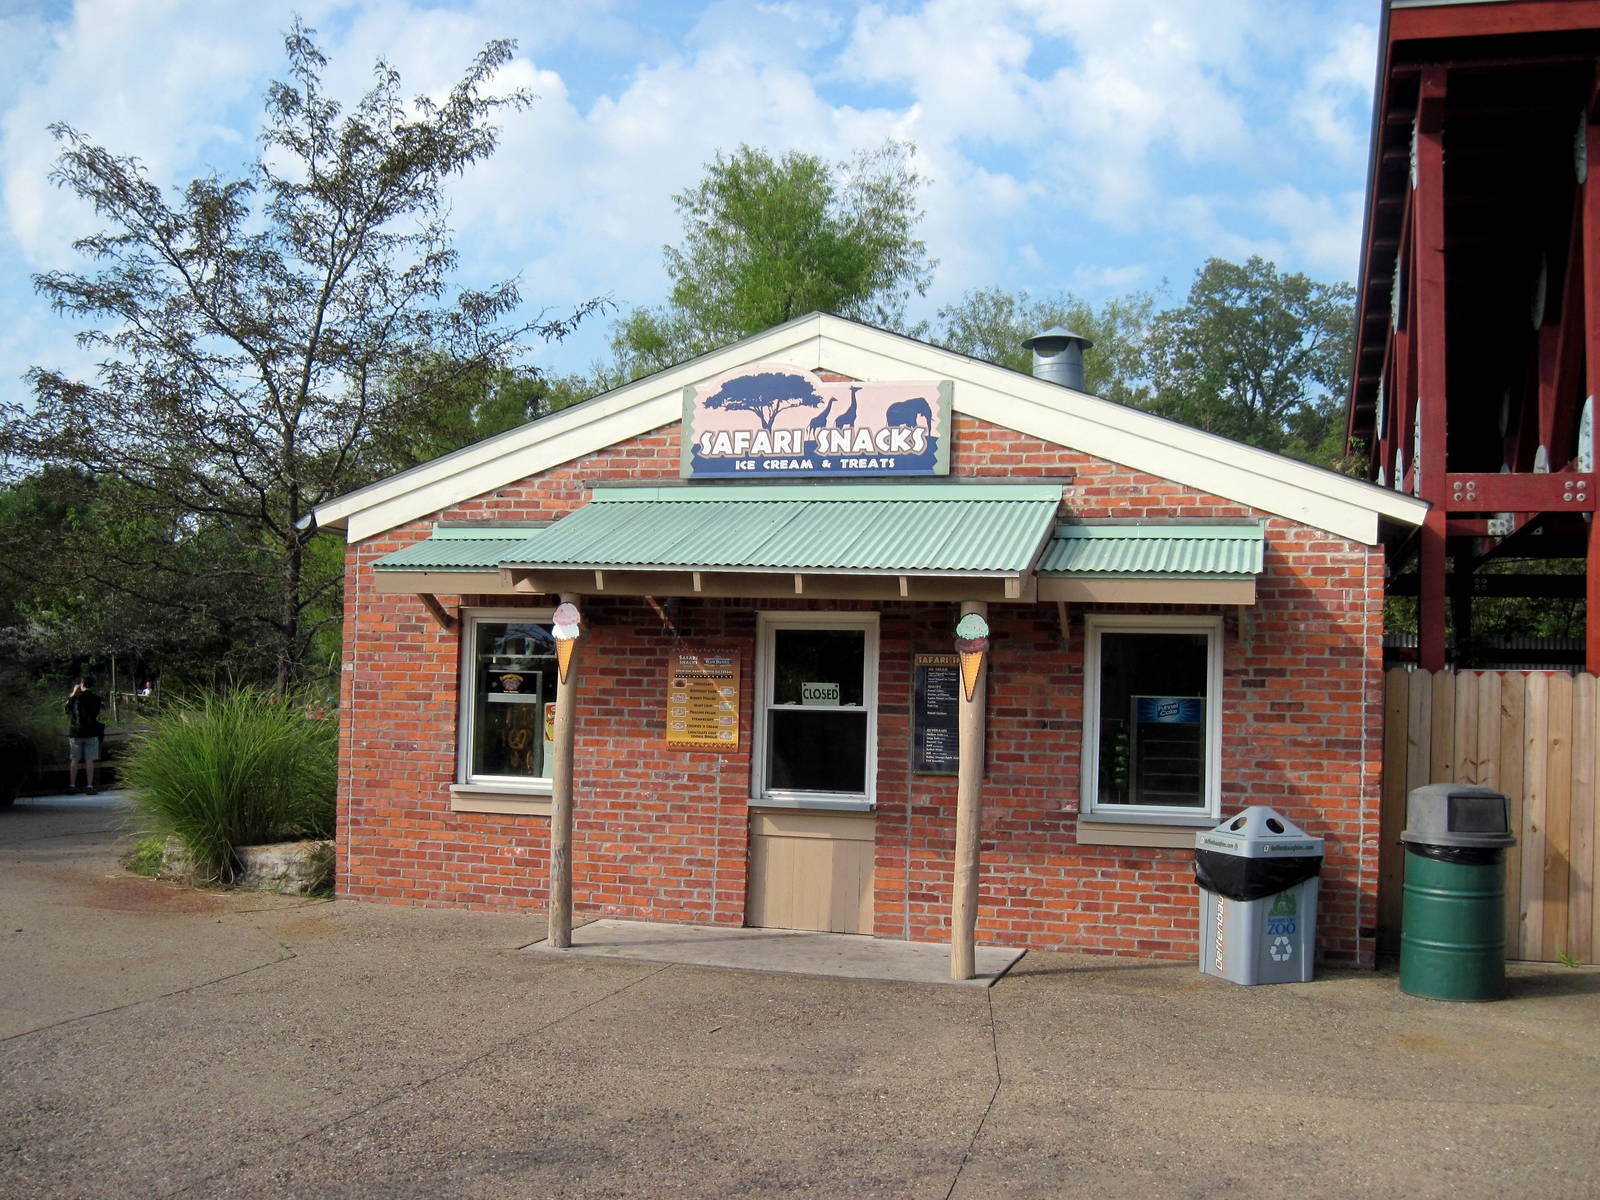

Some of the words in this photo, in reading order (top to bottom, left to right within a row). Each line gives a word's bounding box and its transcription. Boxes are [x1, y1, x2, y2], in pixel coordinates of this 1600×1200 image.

[699, 428, 803, 456] SAFARI
[816, 426, 927, 455] SNACKS
[735, 459, 755, 470] ICE
[763, 459, 813, 470] CREAM
[821, 459, 831, 468] &
[840, 458, 895, 468] TREATS
[803, 688, 839, 700] CLOSED
[1267, 923, 1297, 936] ZOO
